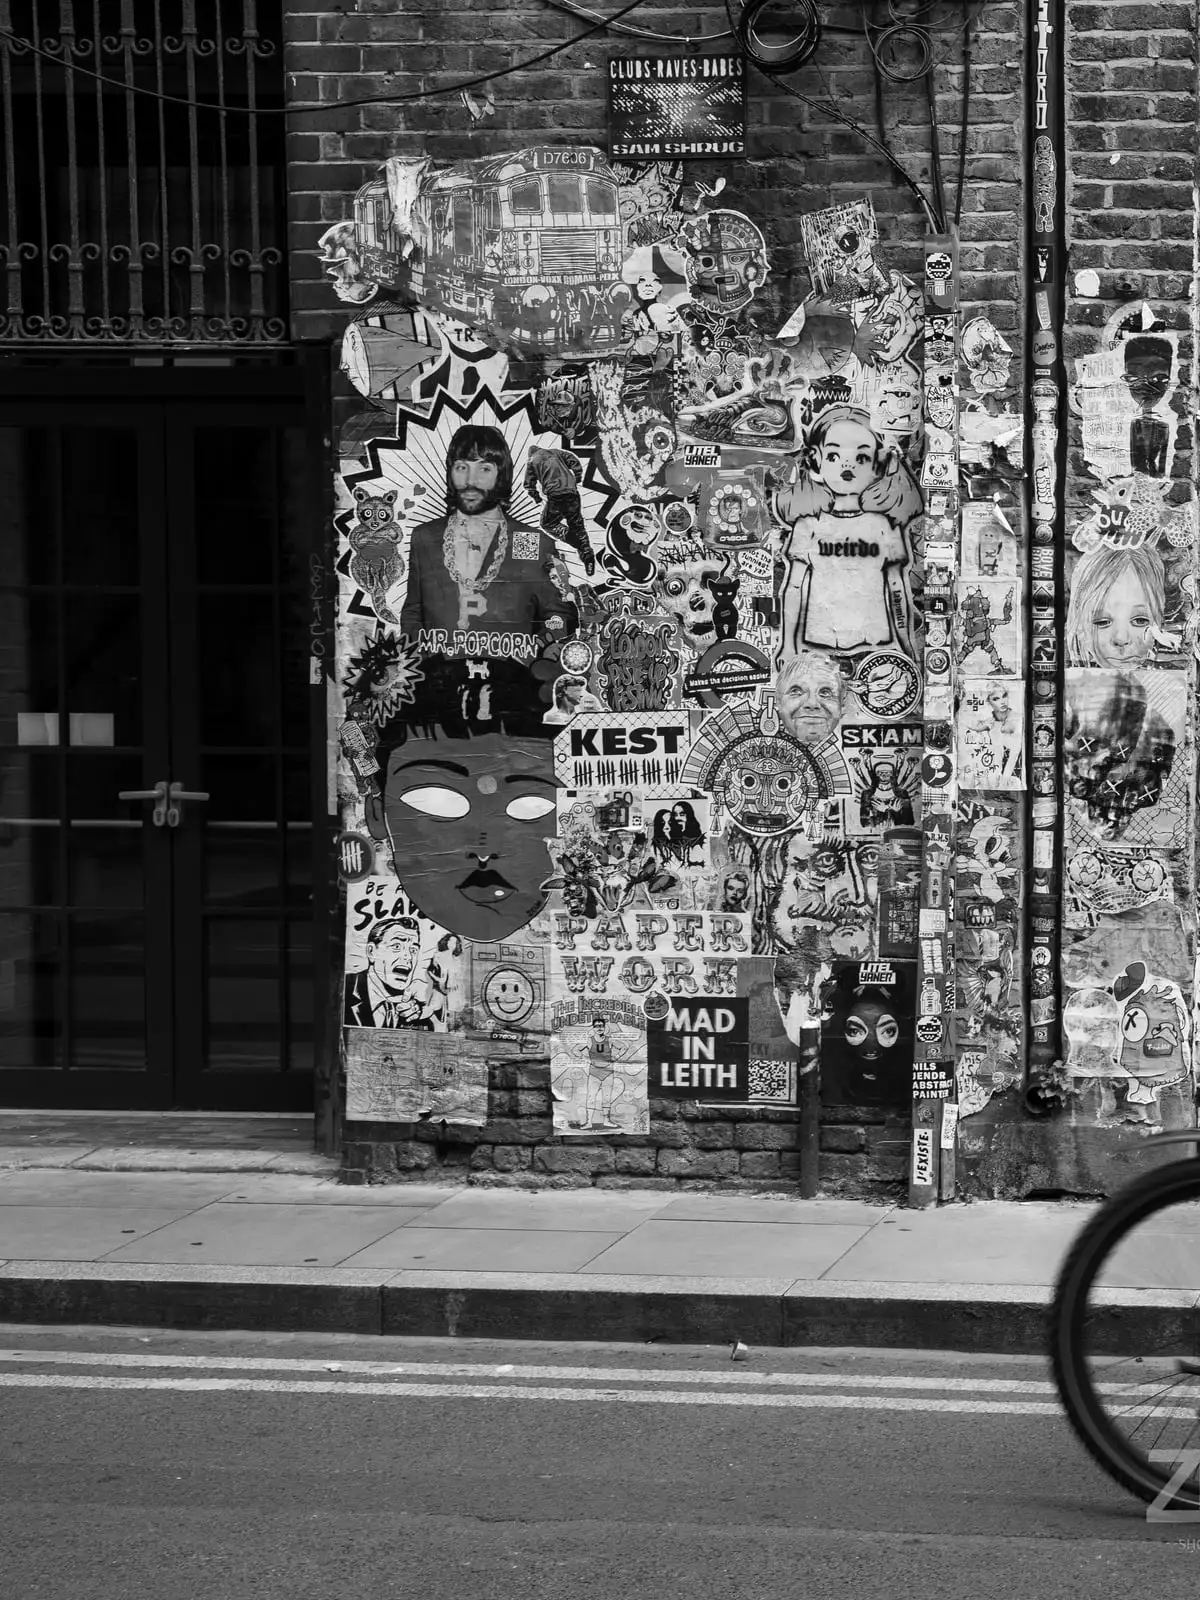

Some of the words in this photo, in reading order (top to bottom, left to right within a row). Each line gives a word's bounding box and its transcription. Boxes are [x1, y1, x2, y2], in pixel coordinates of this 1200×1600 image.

[612, 143, 661, 154] SAM
[664, 141, 744, 153] SHRUG
[543, 152, 587, 164] D7606
[685, 445, 719, 456] LITEL
[817, 536, 880, 557] weirdo
[721, 674, 749, 684] decision
[570, 726, 685, 757] KEST
[842, 727, 923, 745] SKAM
[365, 881, 389, 898] BE
[554, 913, 749, 952] PAPER
[560, 955, 738, 995] WORK
[859, 962, 893, 973] LITEL
[551, 1000, 575, 1020] THE
[664, 1007, 737, 1033] MAD
[596, 1044, 605, 1053] U
[681, 1036, 716, 1061] IN
[660, 1062, 738, 1088] LEITH
[912, 1062, 937, 1071] NILS
[916, 1131, 930, 1183] J'EXISTE.
